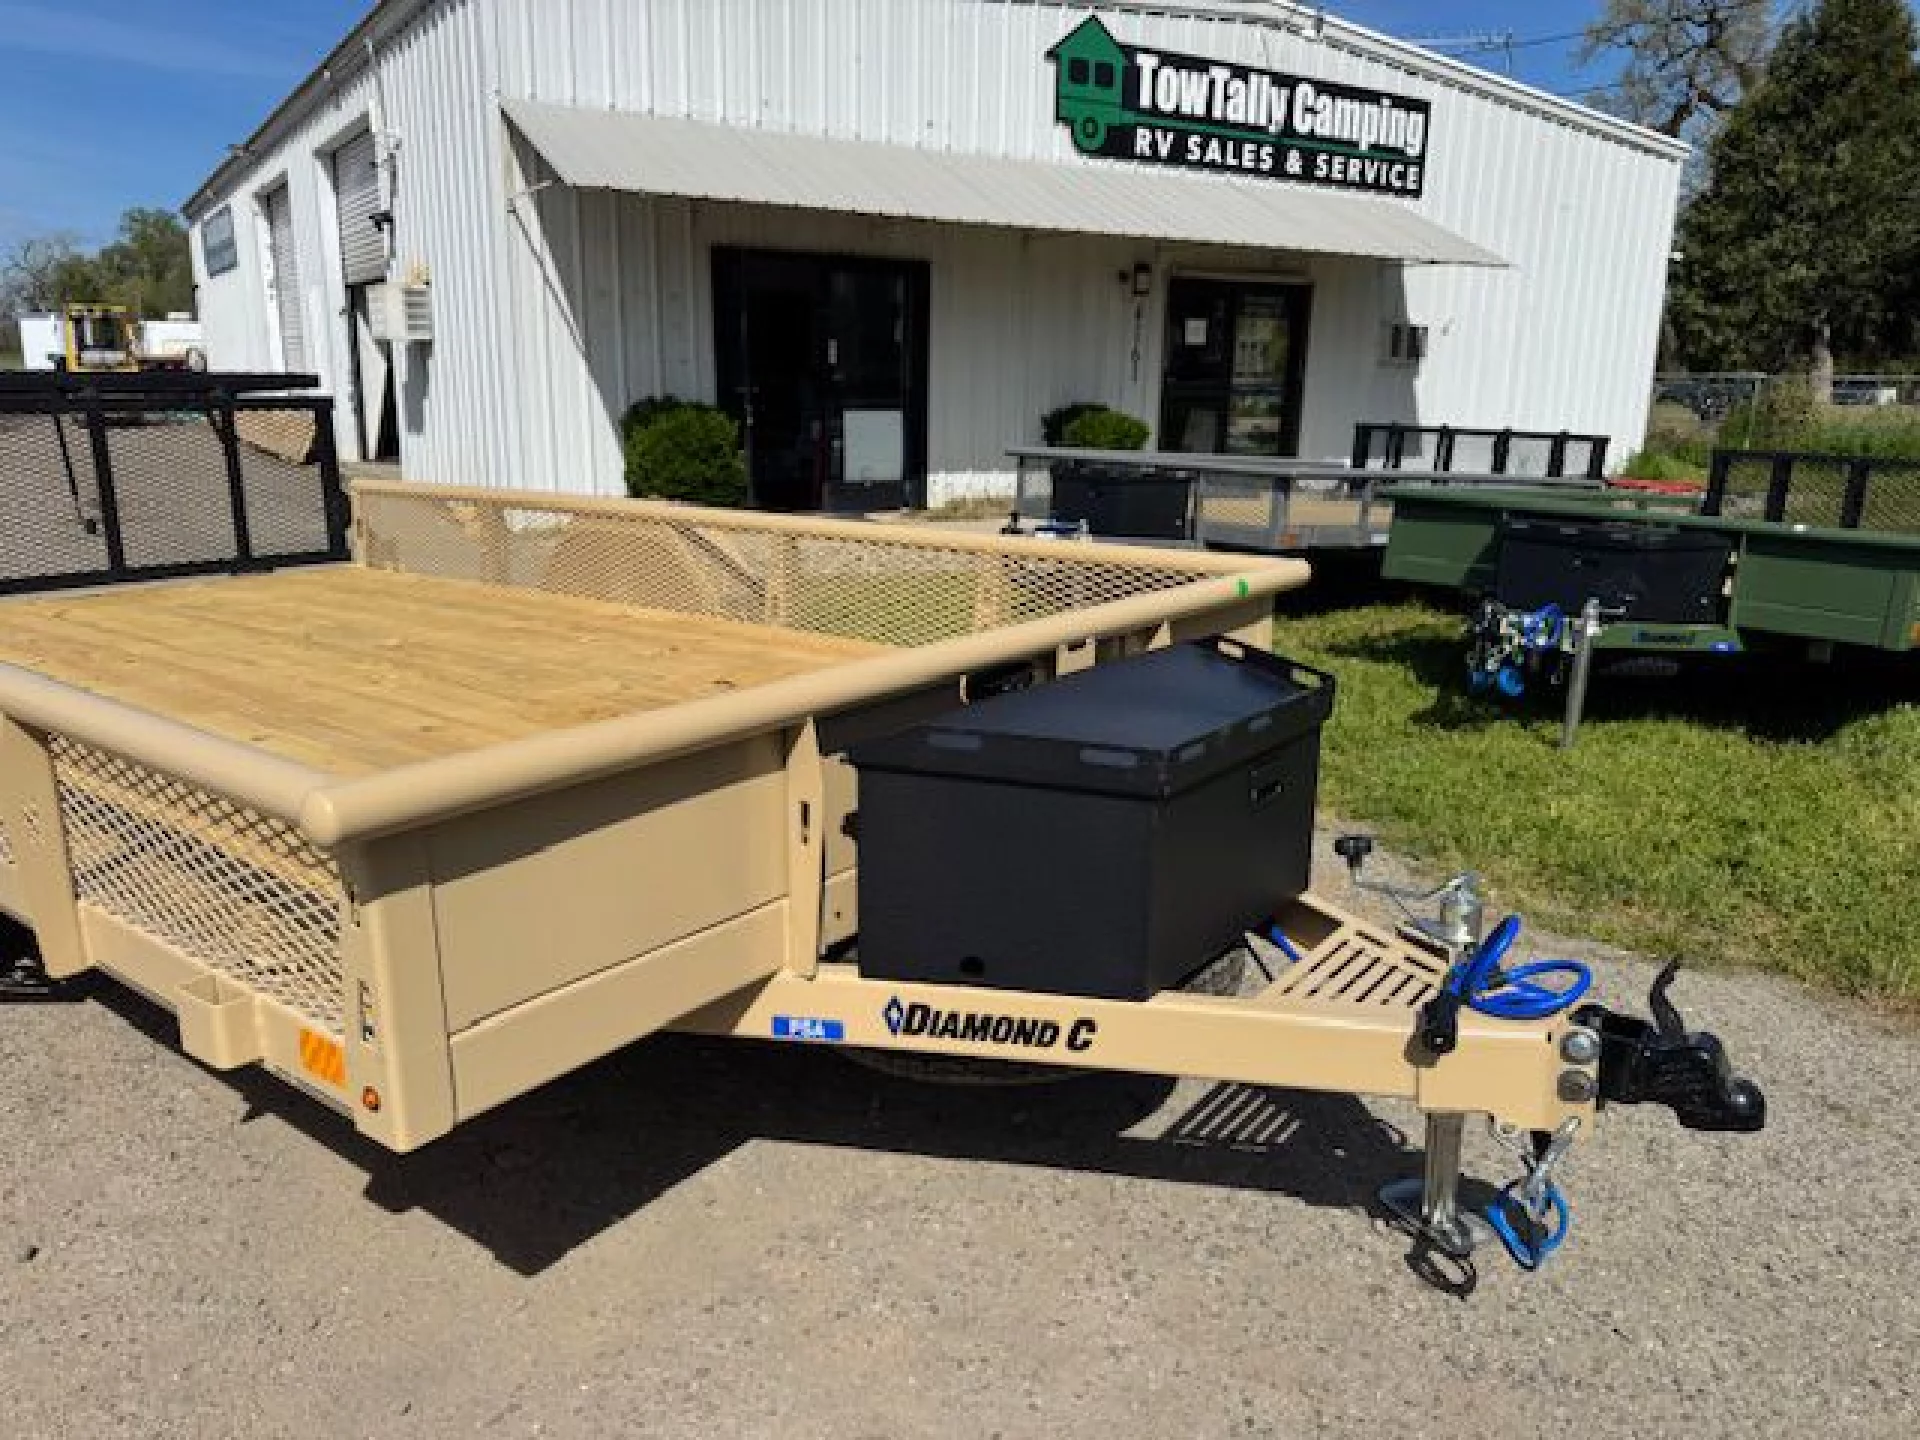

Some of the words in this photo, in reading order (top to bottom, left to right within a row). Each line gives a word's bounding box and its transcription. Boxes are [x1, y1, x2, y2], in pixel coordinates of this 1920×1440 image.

[1293, 80, 1426, 156] Camping
[1134, 127, 1174, 157] RV
[1187, 136, 1274, 170] SALES
[1286, 150, 1302, 175] &
[1315, 154, 1421, 190] SERVICE
[903, 1002, 1060, 1048] DIAMOND
[1065, 1017, 1098, 1052] C
